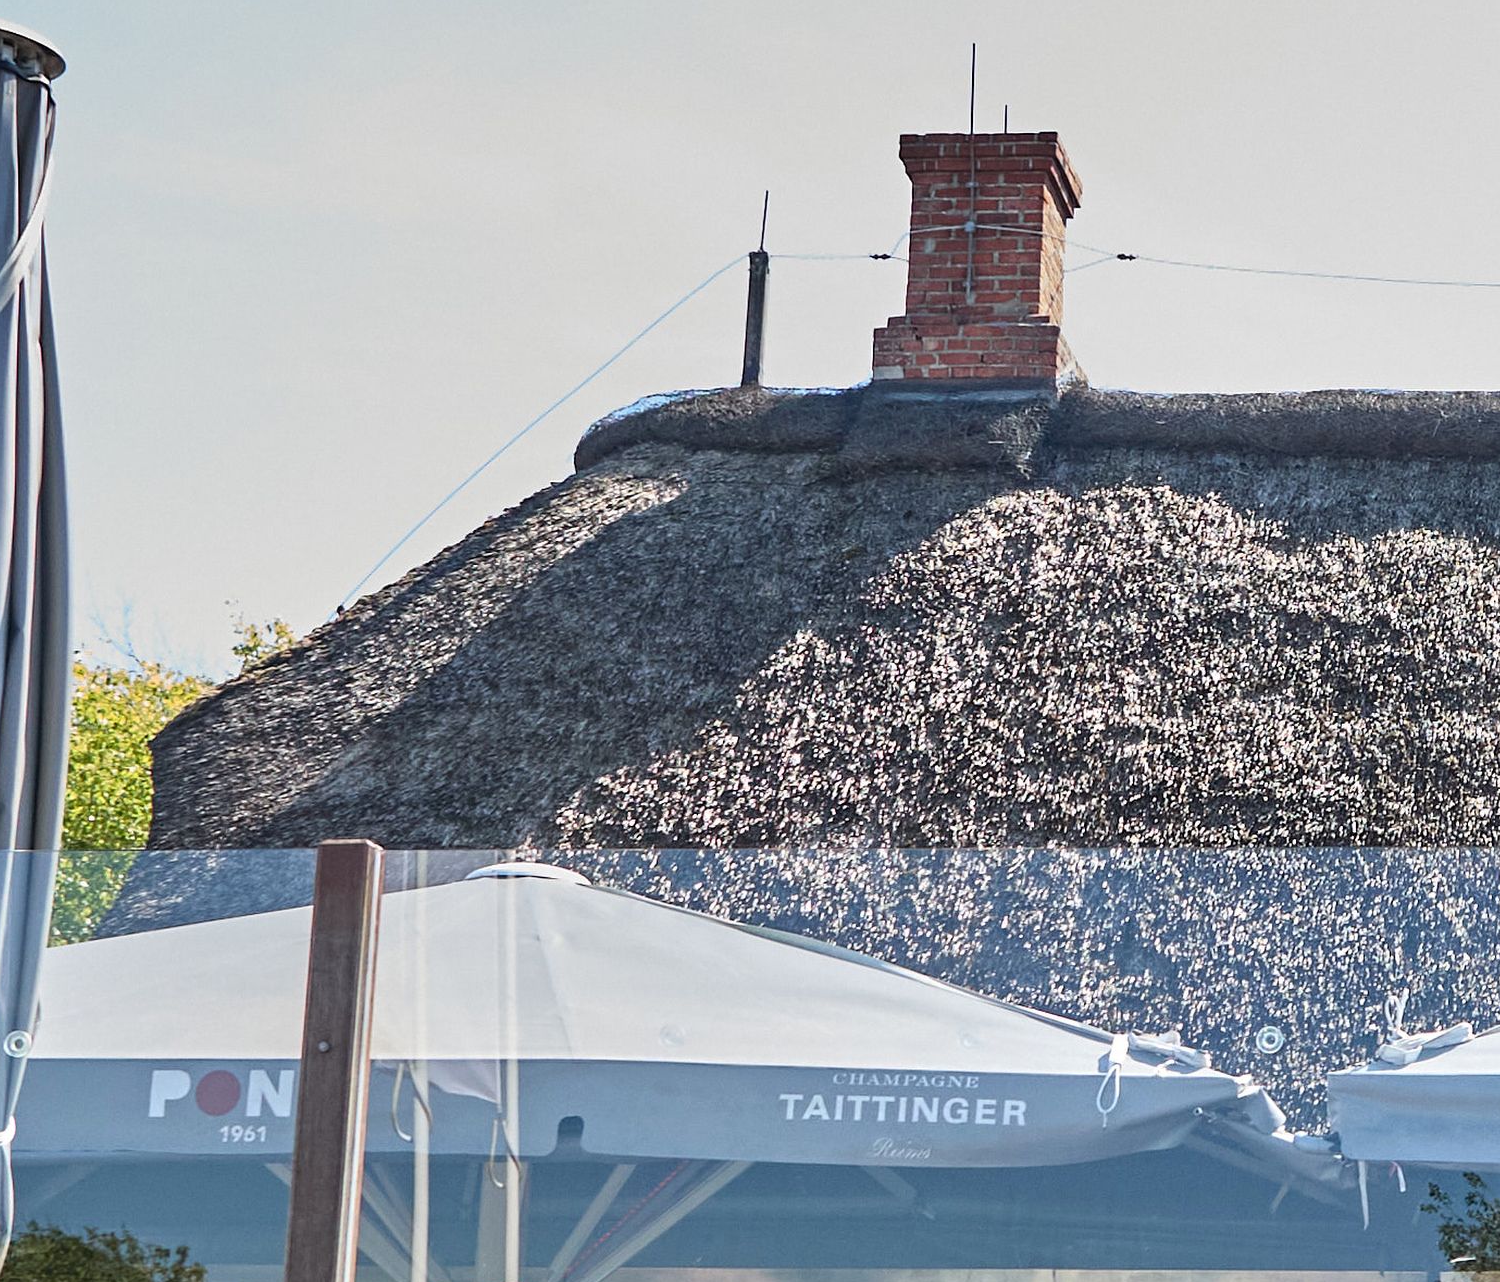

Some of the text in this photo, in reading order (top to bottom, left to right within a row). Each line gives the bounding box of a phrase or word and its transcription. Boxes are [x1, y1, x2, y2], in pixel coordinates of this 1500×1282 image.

[832, 1073, 980, 1089] CHAMPAGNE
[148, 1070, 295, 1118] PON
[779, 1093, 1028, 1126] TAITTINGER
[219, 1125, 267, 1143] 1961
[868, 1136, 933, 1160] Reims
